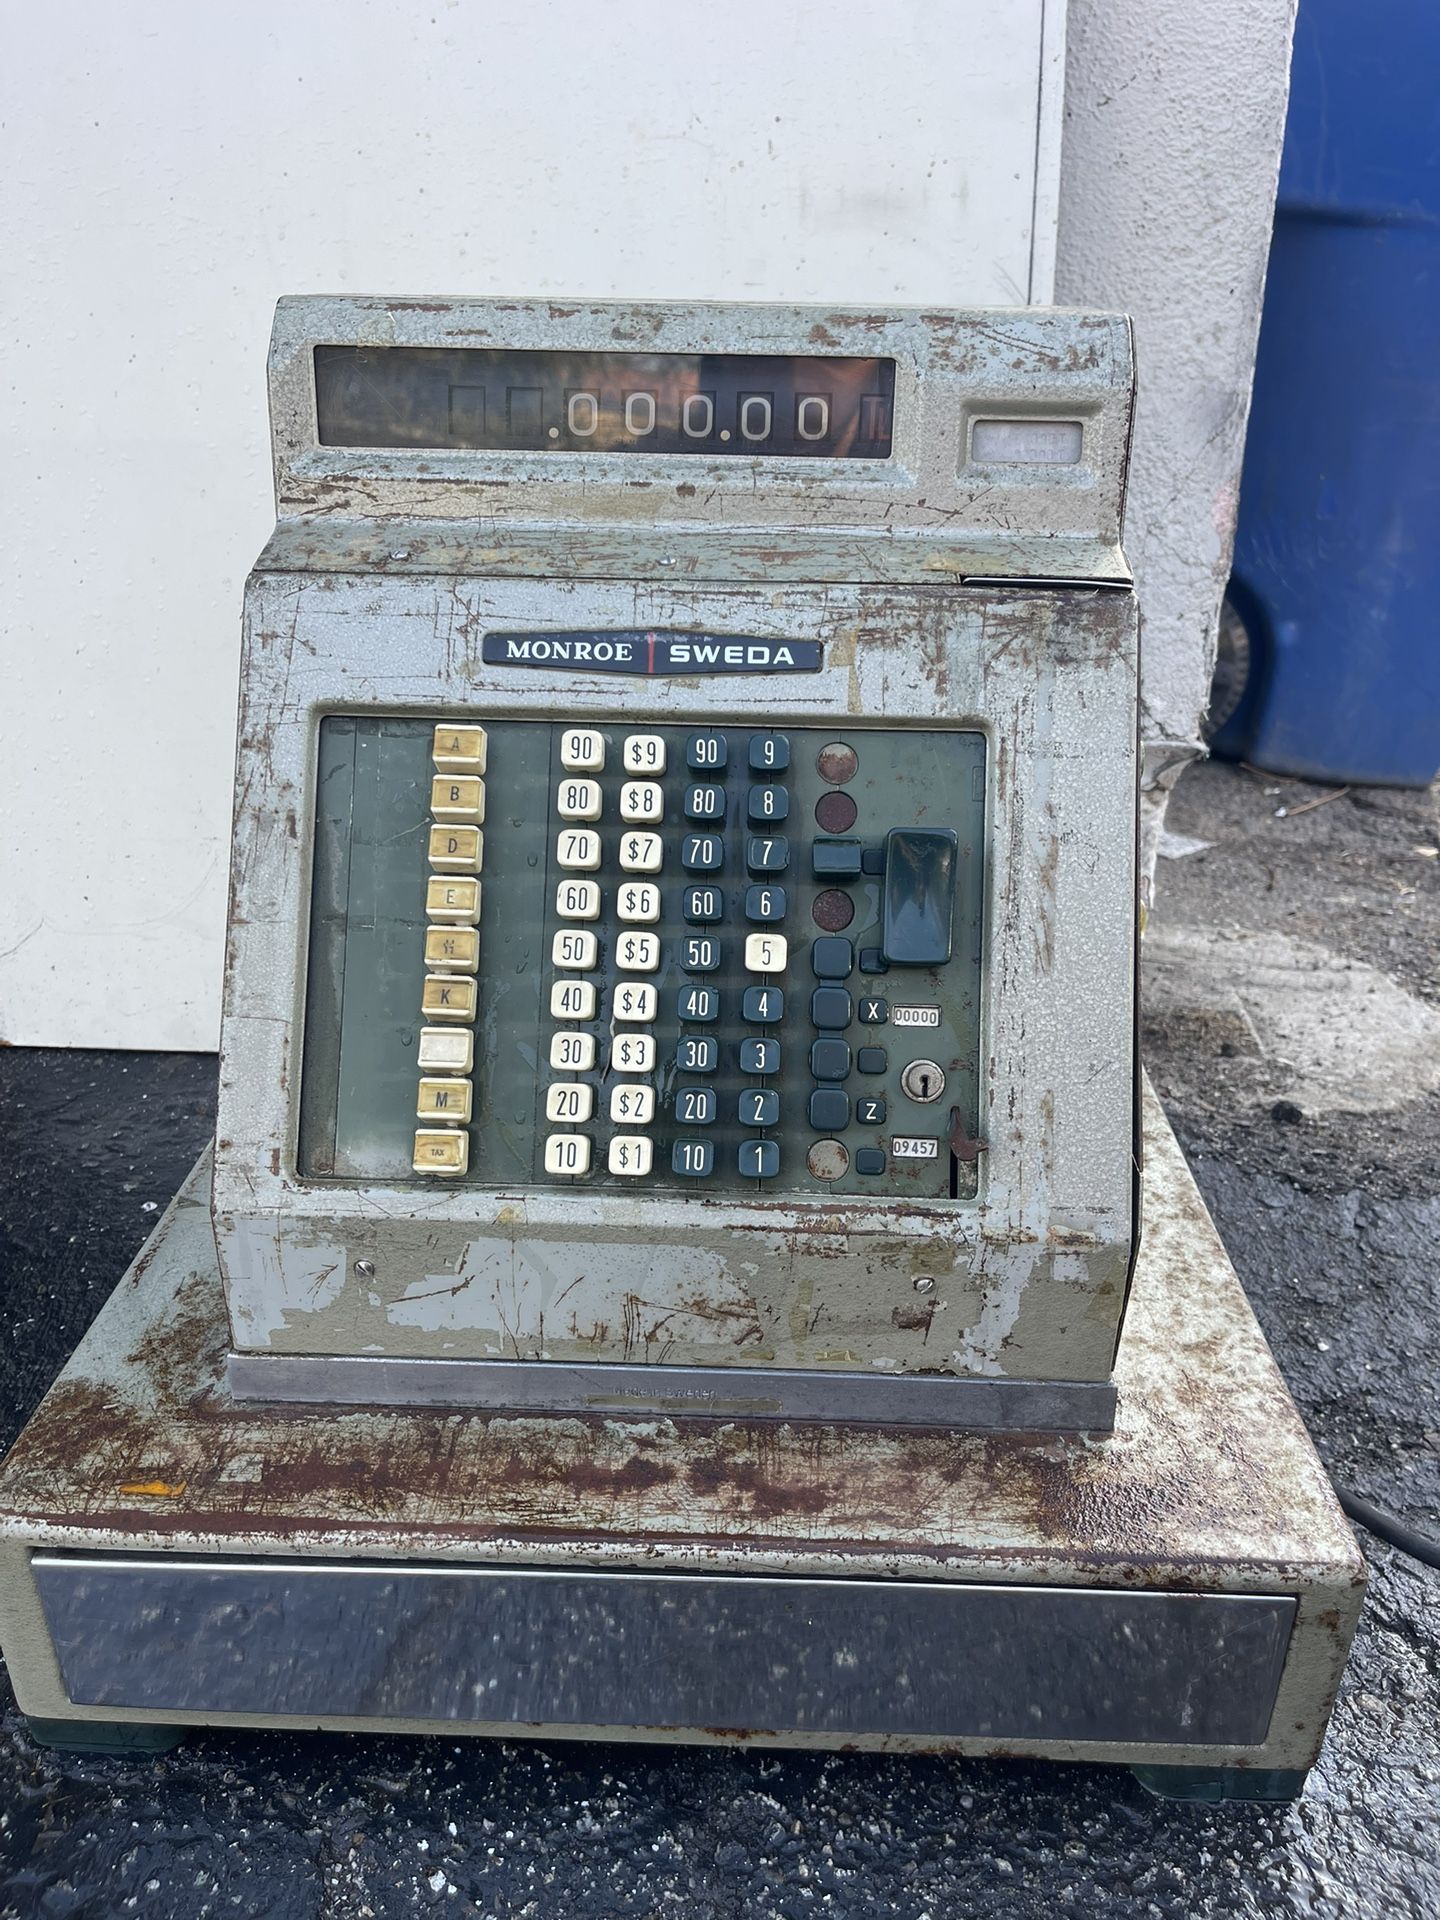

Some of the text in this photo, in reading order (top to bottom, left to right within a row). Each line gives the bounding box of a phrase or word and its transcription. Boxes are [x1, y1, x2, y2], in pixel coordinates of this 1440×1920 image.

[506, 640, 795, 665] MONROE SWEDA
[450, 736, 460, 752] A
[571, 736, 591, 759] 90
[632, 742, 655, 764] $9
[697, 739, 717, 763] 90
[765, 741, 773, 764] 9
[450, 785, 460, 801] B
[568, 786, 588, 809] 80
[629, 789, 652, 812] $8
[693, 789, 714, 813] 80
[765, 791, 773, 814] 8
[447, 838, 458, 853] D
[567, 836, 587, 859] 70
[629, 839, 653, 862] $7
[691, 839, 712, 863] 70
[763, 841, 772, 864] 7
[446, 889, 455, 904] E
[567, 887, 587, 910] 60
[626, 890, 649, 913] $6
[693, 892, 713, 915] 60
[761, 892, 770, 915] 6
[563, 937, 583, 960] 50
[625, 939, 649, 963] $5
[689, 941, 710, 965] 50
[762, 941, 771, 965] 5
[440, 988, 451, 1005] K
[561, 988, 581, 1011] 40
[623, 990, 646, 1014] $4
[687, 991, 708, 1016] 40
[759, 993, 767, 1016] 4
[868, 1003, 879, 1019] X
[894, 1009, 937, 1024] 00000
[560, 1039, 581, 1063] 30
[621, 1041, 644, 1065] $3
[686, 1042, 707, 1067] 30
[756, 1044, 765, 1068] 3
[435, 1091, 448, 1108] M
[557, 1091, 578, 1115] 20
[620, 1092, 644, 1116] $2
[685, 1094, 706, 1119] 20
[754, 1096, 763, 1120] 2
[865, 1103, 877, 1120] Z
[556, 1142, 576, 1167] 10
[619, 1144, 640, 1168] $1
[684, 1145, 704, 1170] 10
[755, 1147, 761, 1172] 1
[893, 1141, 936, 1155] 09457
